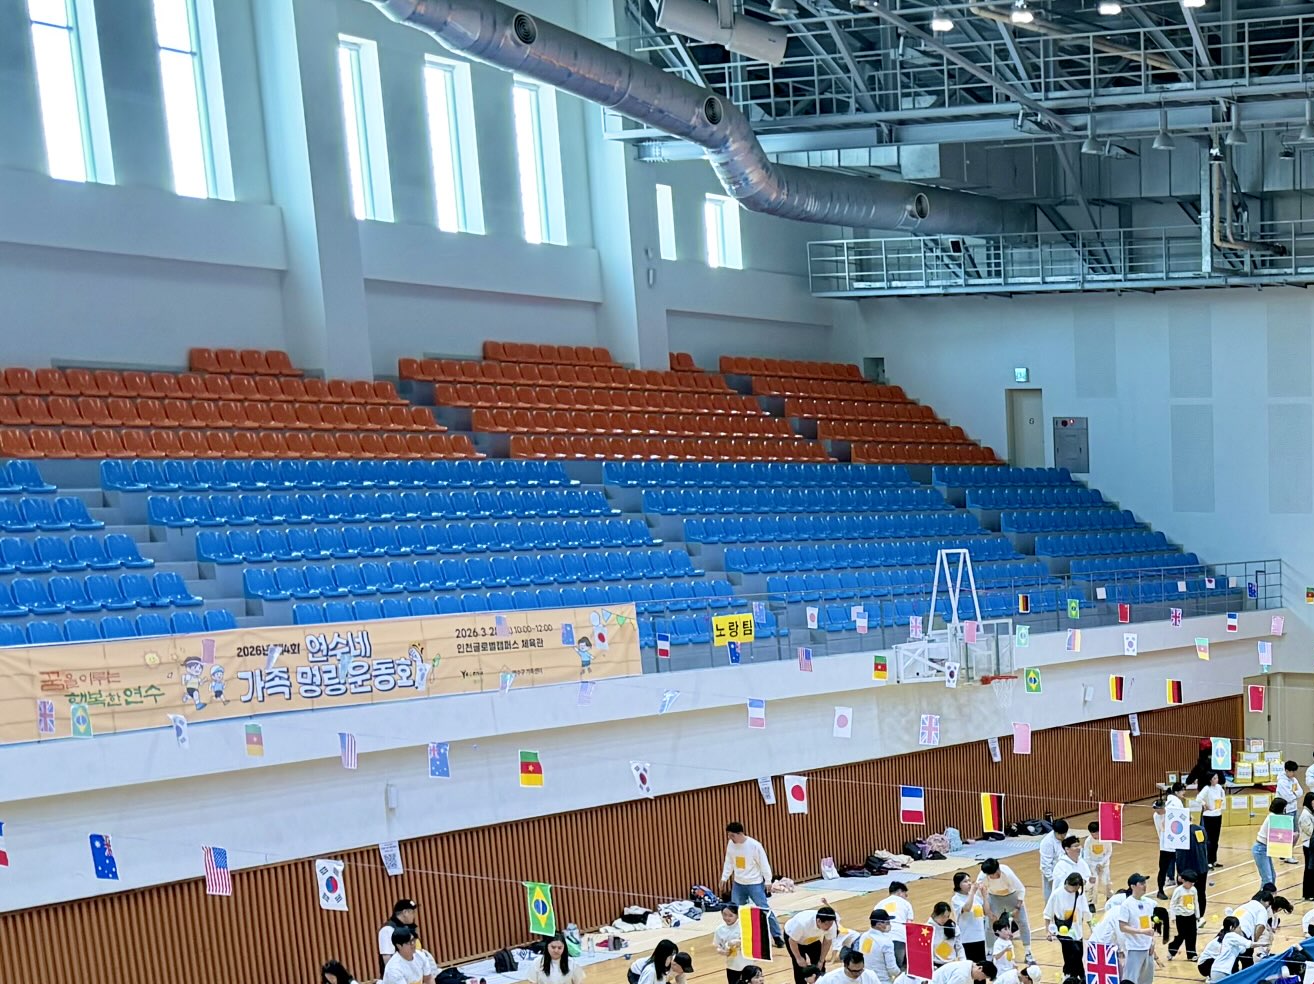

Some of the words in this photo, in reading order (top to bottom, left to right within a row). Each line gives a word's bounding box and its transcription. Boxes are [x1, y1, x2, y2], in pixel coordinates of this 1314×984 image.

[715, 619, 753, 638] 노랑팀
[305, 630, 372, 663] 연수네
[456, 641, 519, 654] 인천글로벌캠퍼스
[522, 637, 544, 649] 체육관
[237, 666, 292, 702] 가족
[296, 655, 422, 699] 명랑운동회
[64, 689, 122, 708] 행복한
[123, 684, 166, 705] 연수
